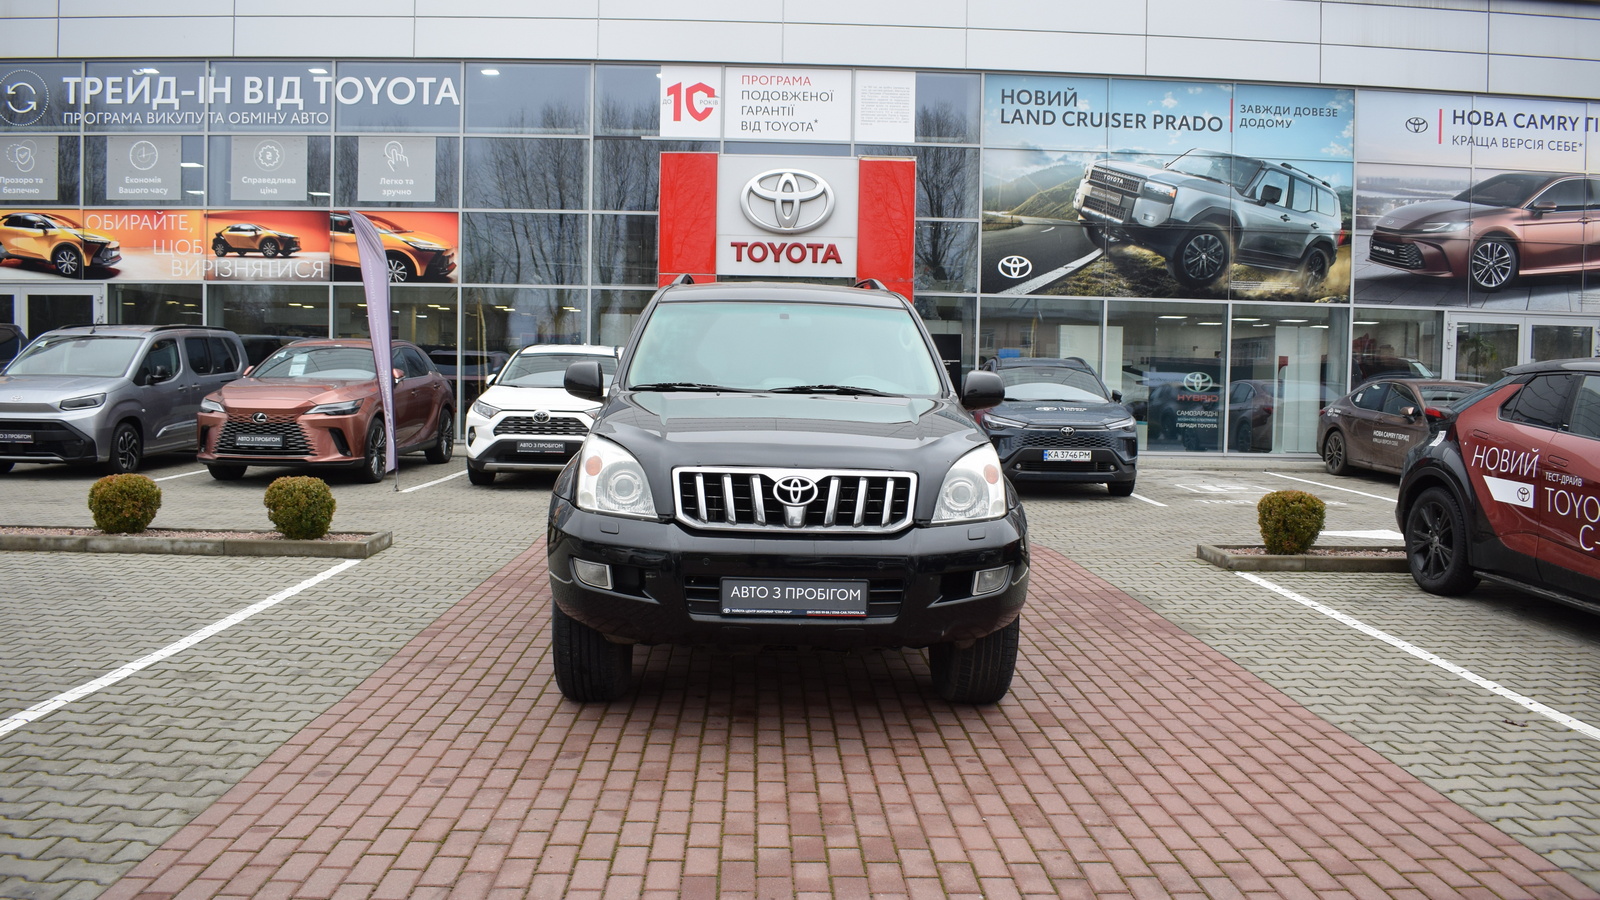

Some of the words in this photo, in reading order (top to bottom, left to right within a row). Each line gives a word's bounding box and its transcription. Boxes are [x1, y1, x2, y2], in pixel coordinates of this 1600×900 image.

[741, 75, 811, 86] ПРОГРАМА
[63, 69, 231, 110] ТРЕЙД-ІН
[244, 77, 303, 110] ВІД
[313, 77, 460, 105] TOYOTA
[741, 89, 834, 102] ПОДОВЖЕНОЇ
[1001, 87, 1078, 107] НОВИЙ
[741, 104, 795, 116] ГАРАНТІЇ
[1240, 104, 1290, 116] ЗАВЖДИ
[1293, 107, 1338, 117] ДОВЕЗЕ
[63, 112, 142, 124] ПРОГРАМА
[147, 112, 205, 124] ВИКУПУ
[207, 112, 224, 124] ТА
[228, 112, 287, 124] ОБМІНУ
[290, 112, 329, 124] АВТО
[1000, 109, 1056, 126] LAND
[1062, 111, 1147, 129] CRUISER
[1153, 114, 1223, 132] PRADO
[1239, 118, 1292, 129] ДОДОМУ
[1452, 109, 1508, 128] НОВА
[1513, 113, 1580, 131] CAMRY
[741, 121, 761, 133] ВІД
[1452, 135, 1498, 149] КРАЩА
[1502, 138, 1544, 150] ВЕРСІЯ
[125, 176, 161, 184] Економія
[241, 176, 296, 185] Справедлива
[379, 177, 404, 185] Легко
[2, 186, 40, 194] безпечно
[118, 186, 149, 194] Вашого
[150, 187, 168, 195] часу
[260, 186, 278, 195] ціна
[382, 189, 412, 197] зручно
[86, 211, 193, 233] ОБИРАЙТЕ,
[153, 239, 204, 257] ЩОБ
[731, 241, 842, 264] TOYOTA
[171, 259, 324, 278] ВИРІЗНЯТИСЯ
[1177, 394, 1219, 402] HYBRID
[1060, 451, 1078, 459] 3746
[1471, 445, 1539, 478] НОВИЙ
[1545, 471, 1583, 487] ТЕСТ-ДРАЙВ
[730, 586, 769, 598] АВТО
[772, 587, 781, 599] З
[785, 587, 861, 601] ПРОБІГОМ
